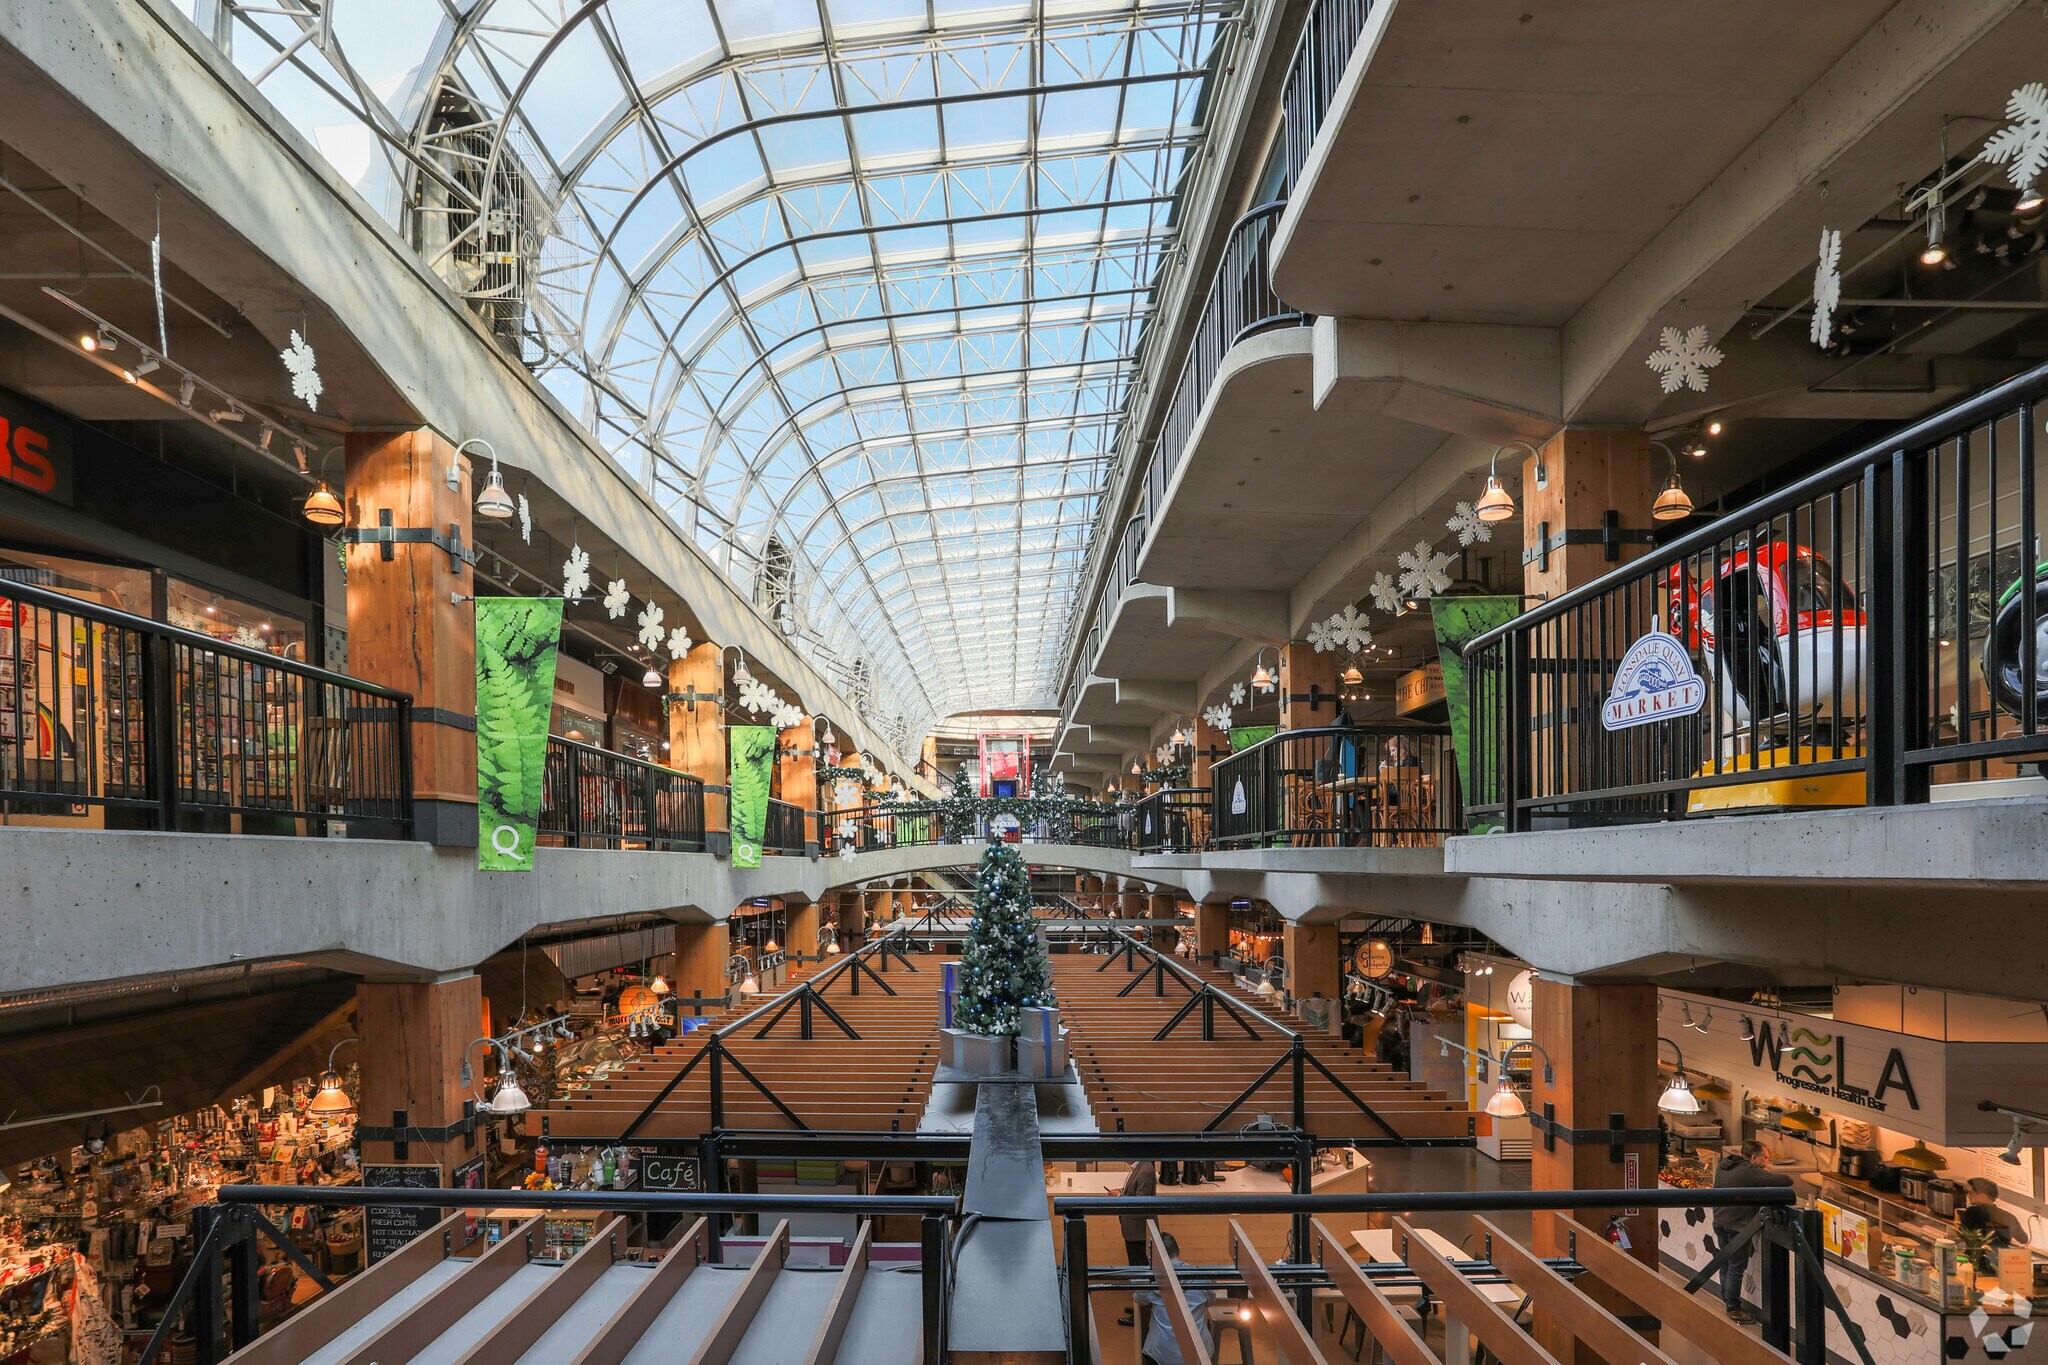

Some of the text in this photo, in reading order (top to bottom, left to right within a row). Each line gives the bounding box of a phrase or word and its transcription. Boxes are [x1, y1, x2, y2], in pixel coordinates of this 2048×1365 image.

[1618, 643, 1686, 693] LONSDALE QUAY
[1612, 687, 1692, 720] MARKET
[491, 825, 526, 860] Q
[738, 844, 756, 864] Q
[1776, 1071, 1888, 1112] Progressive Health Bar
[647, 1161, 694, 1188] Café
[370, 1207, 401, 1215] COOKIES
[393, 1219, 418, 1227] COFFEE
